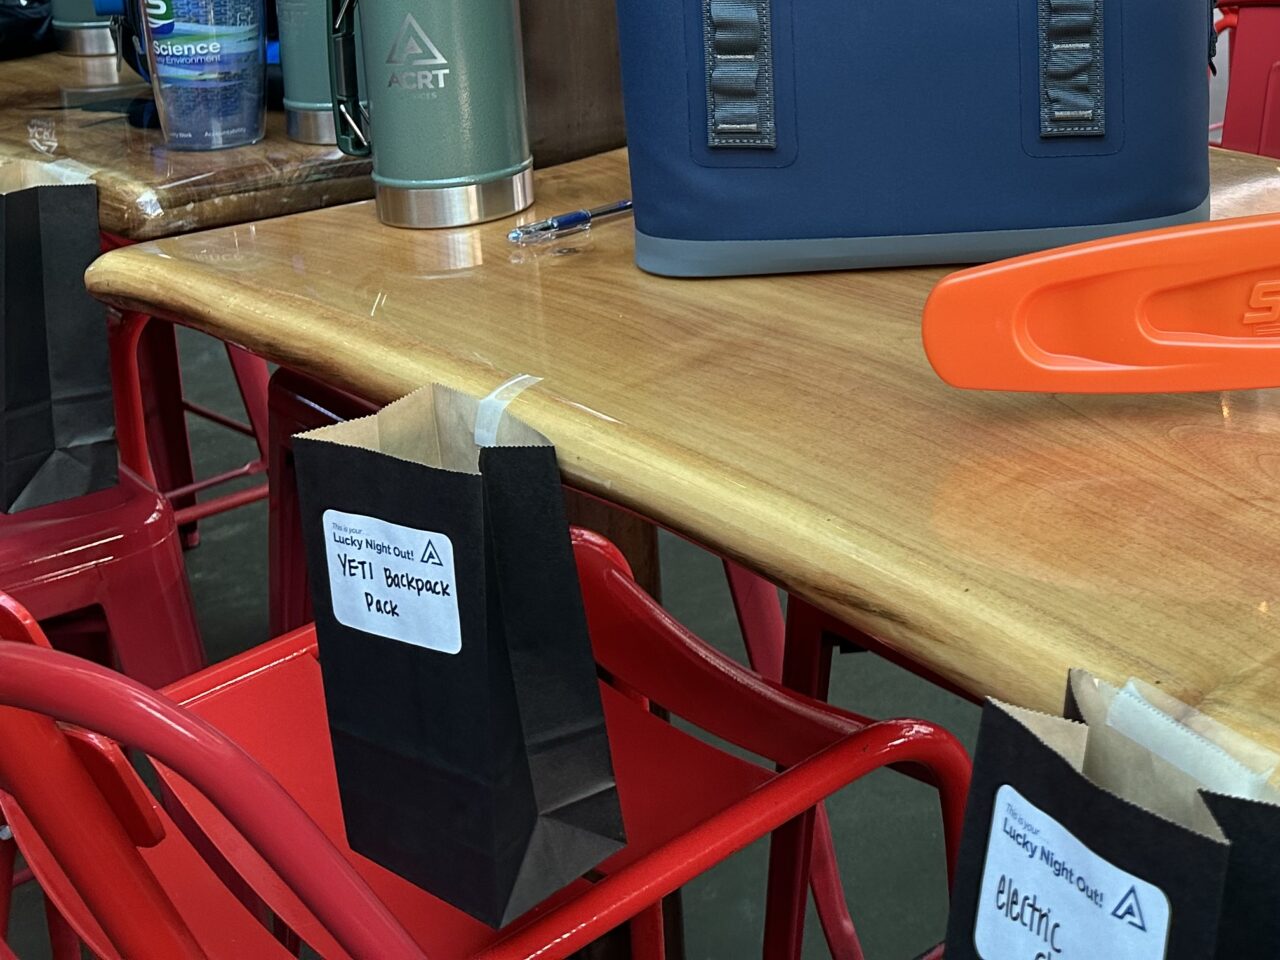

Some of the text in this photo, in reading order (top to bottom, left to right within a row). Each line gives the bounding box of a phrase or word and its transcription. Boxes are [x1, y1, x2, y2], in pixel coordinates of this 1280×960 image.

[154, 40, 221, 56] Science
[166, 54, 221, 65] Environment
[388, 68, 450, 90] ACRT
[332, 522, 343, 531] This
[333, 532, 415, 561] Lucky Night Out!
[337, 553, 451, 597] YETI Backpack
[364, 591, 400, 617] Pack
[1006, 803, 1018, 819] This
[1003, 817, 1104, 908] Lucky Night Out!
[995, 873, 1062, 954] electric
